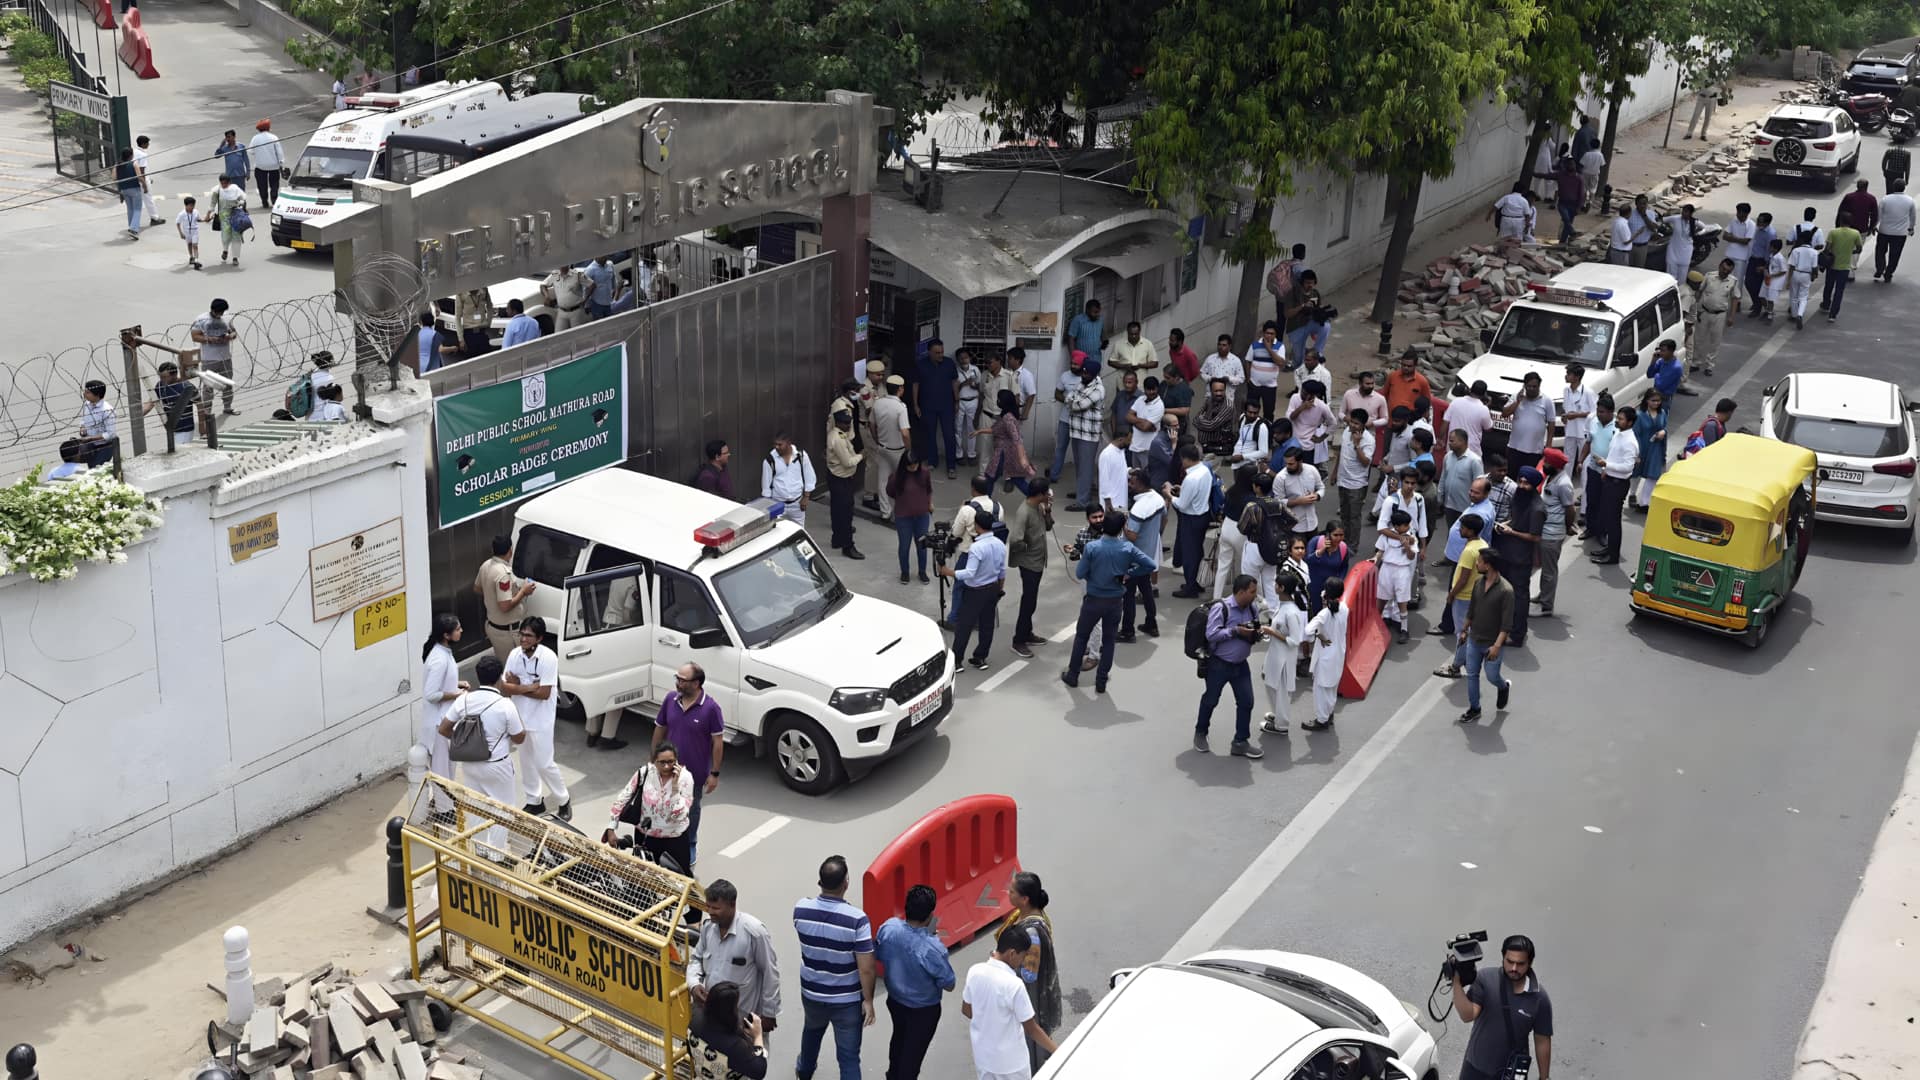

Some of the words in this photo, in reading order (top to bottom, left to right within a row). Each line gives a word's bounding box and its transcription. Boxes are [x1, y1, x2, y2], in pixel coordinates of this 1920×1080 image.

[52, 87, 83, 111] PRIMARY
[87, 97, 109, 119] WING
[416, 210, 552, 284] DELHI
[563, 175, 710, 249] PUBLIC
[719, 145, 849, 209] SCHOOL
[446, 433, 476, 455] DELHI
[477, 423, 511, 444] PUBLIC
[512, 410, 548, 433] SCHOOL
[549, 398, 591, 420] MATHURA
[592, 387, 616, 406] ROAD
[510, 430, 539, 444] PRIMARY
[540, 423, 558, 434] WING
[454, 467, 509, 497] SCHOLAR
[511, 452, 549, 477] BADGE
[550, 431, 609, 463] CEREMONY
[479, 486, 514, 507] SESSION
[236, 526, 246, 537] NO
[447, 873, 500, 929] DELHI
[508, 899, 577, 963] PUBLIC
[513, 938, 571, 979] MATHURA
[575, 968, 606, 993] ROAD
